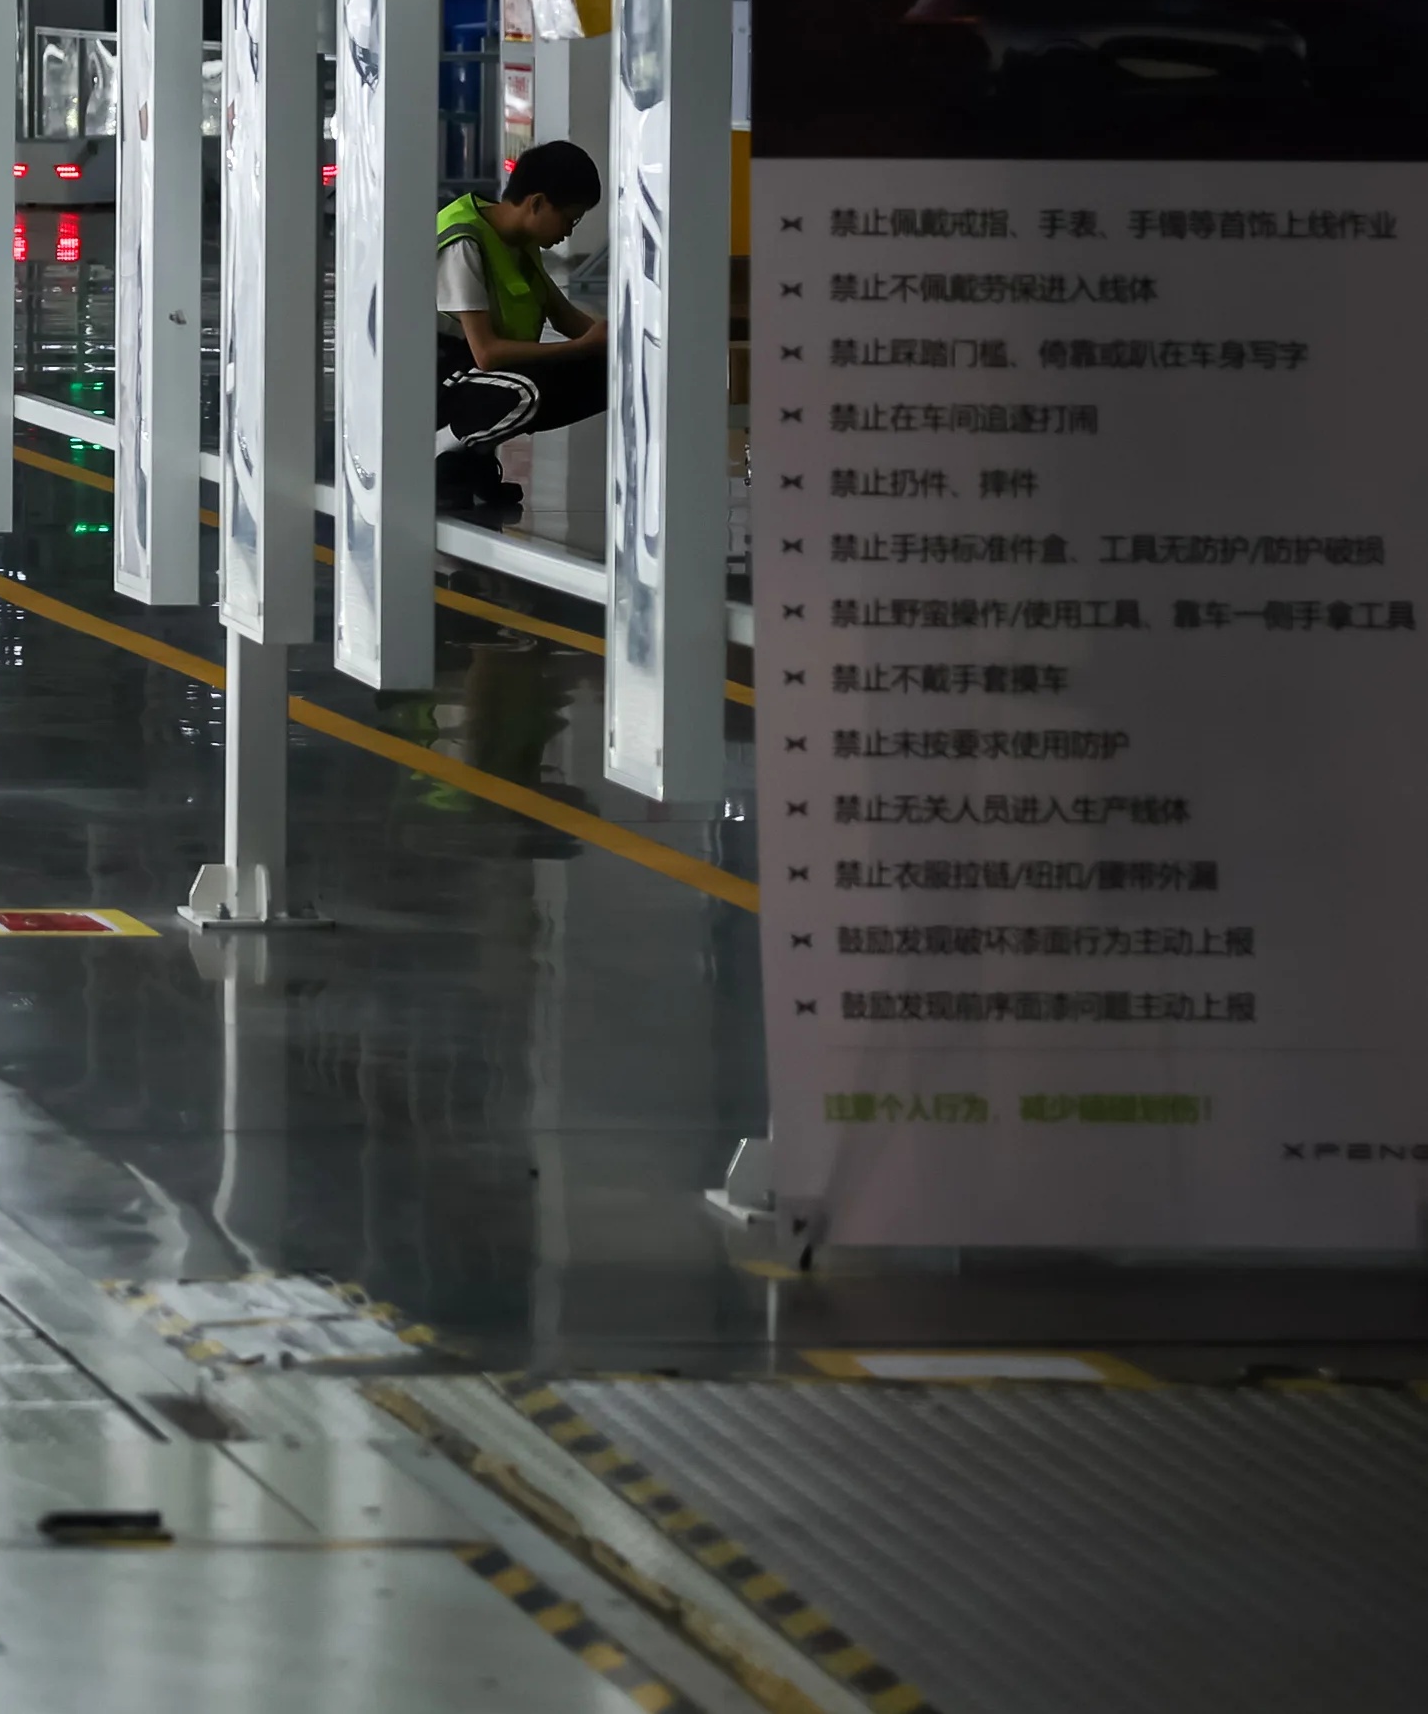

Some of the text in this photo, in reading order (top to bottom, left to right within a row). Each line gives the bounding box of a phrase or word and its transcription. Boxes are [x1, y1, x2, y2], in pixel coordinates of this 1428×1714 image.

[829, 273, 1158, 305] 禁止不佩戴劳保进入线体
[829, 403, 1099, 436] 禁止在车间追逐打闹
[833, 793, 1192, 825] 禁止无关人员进入生产线体
